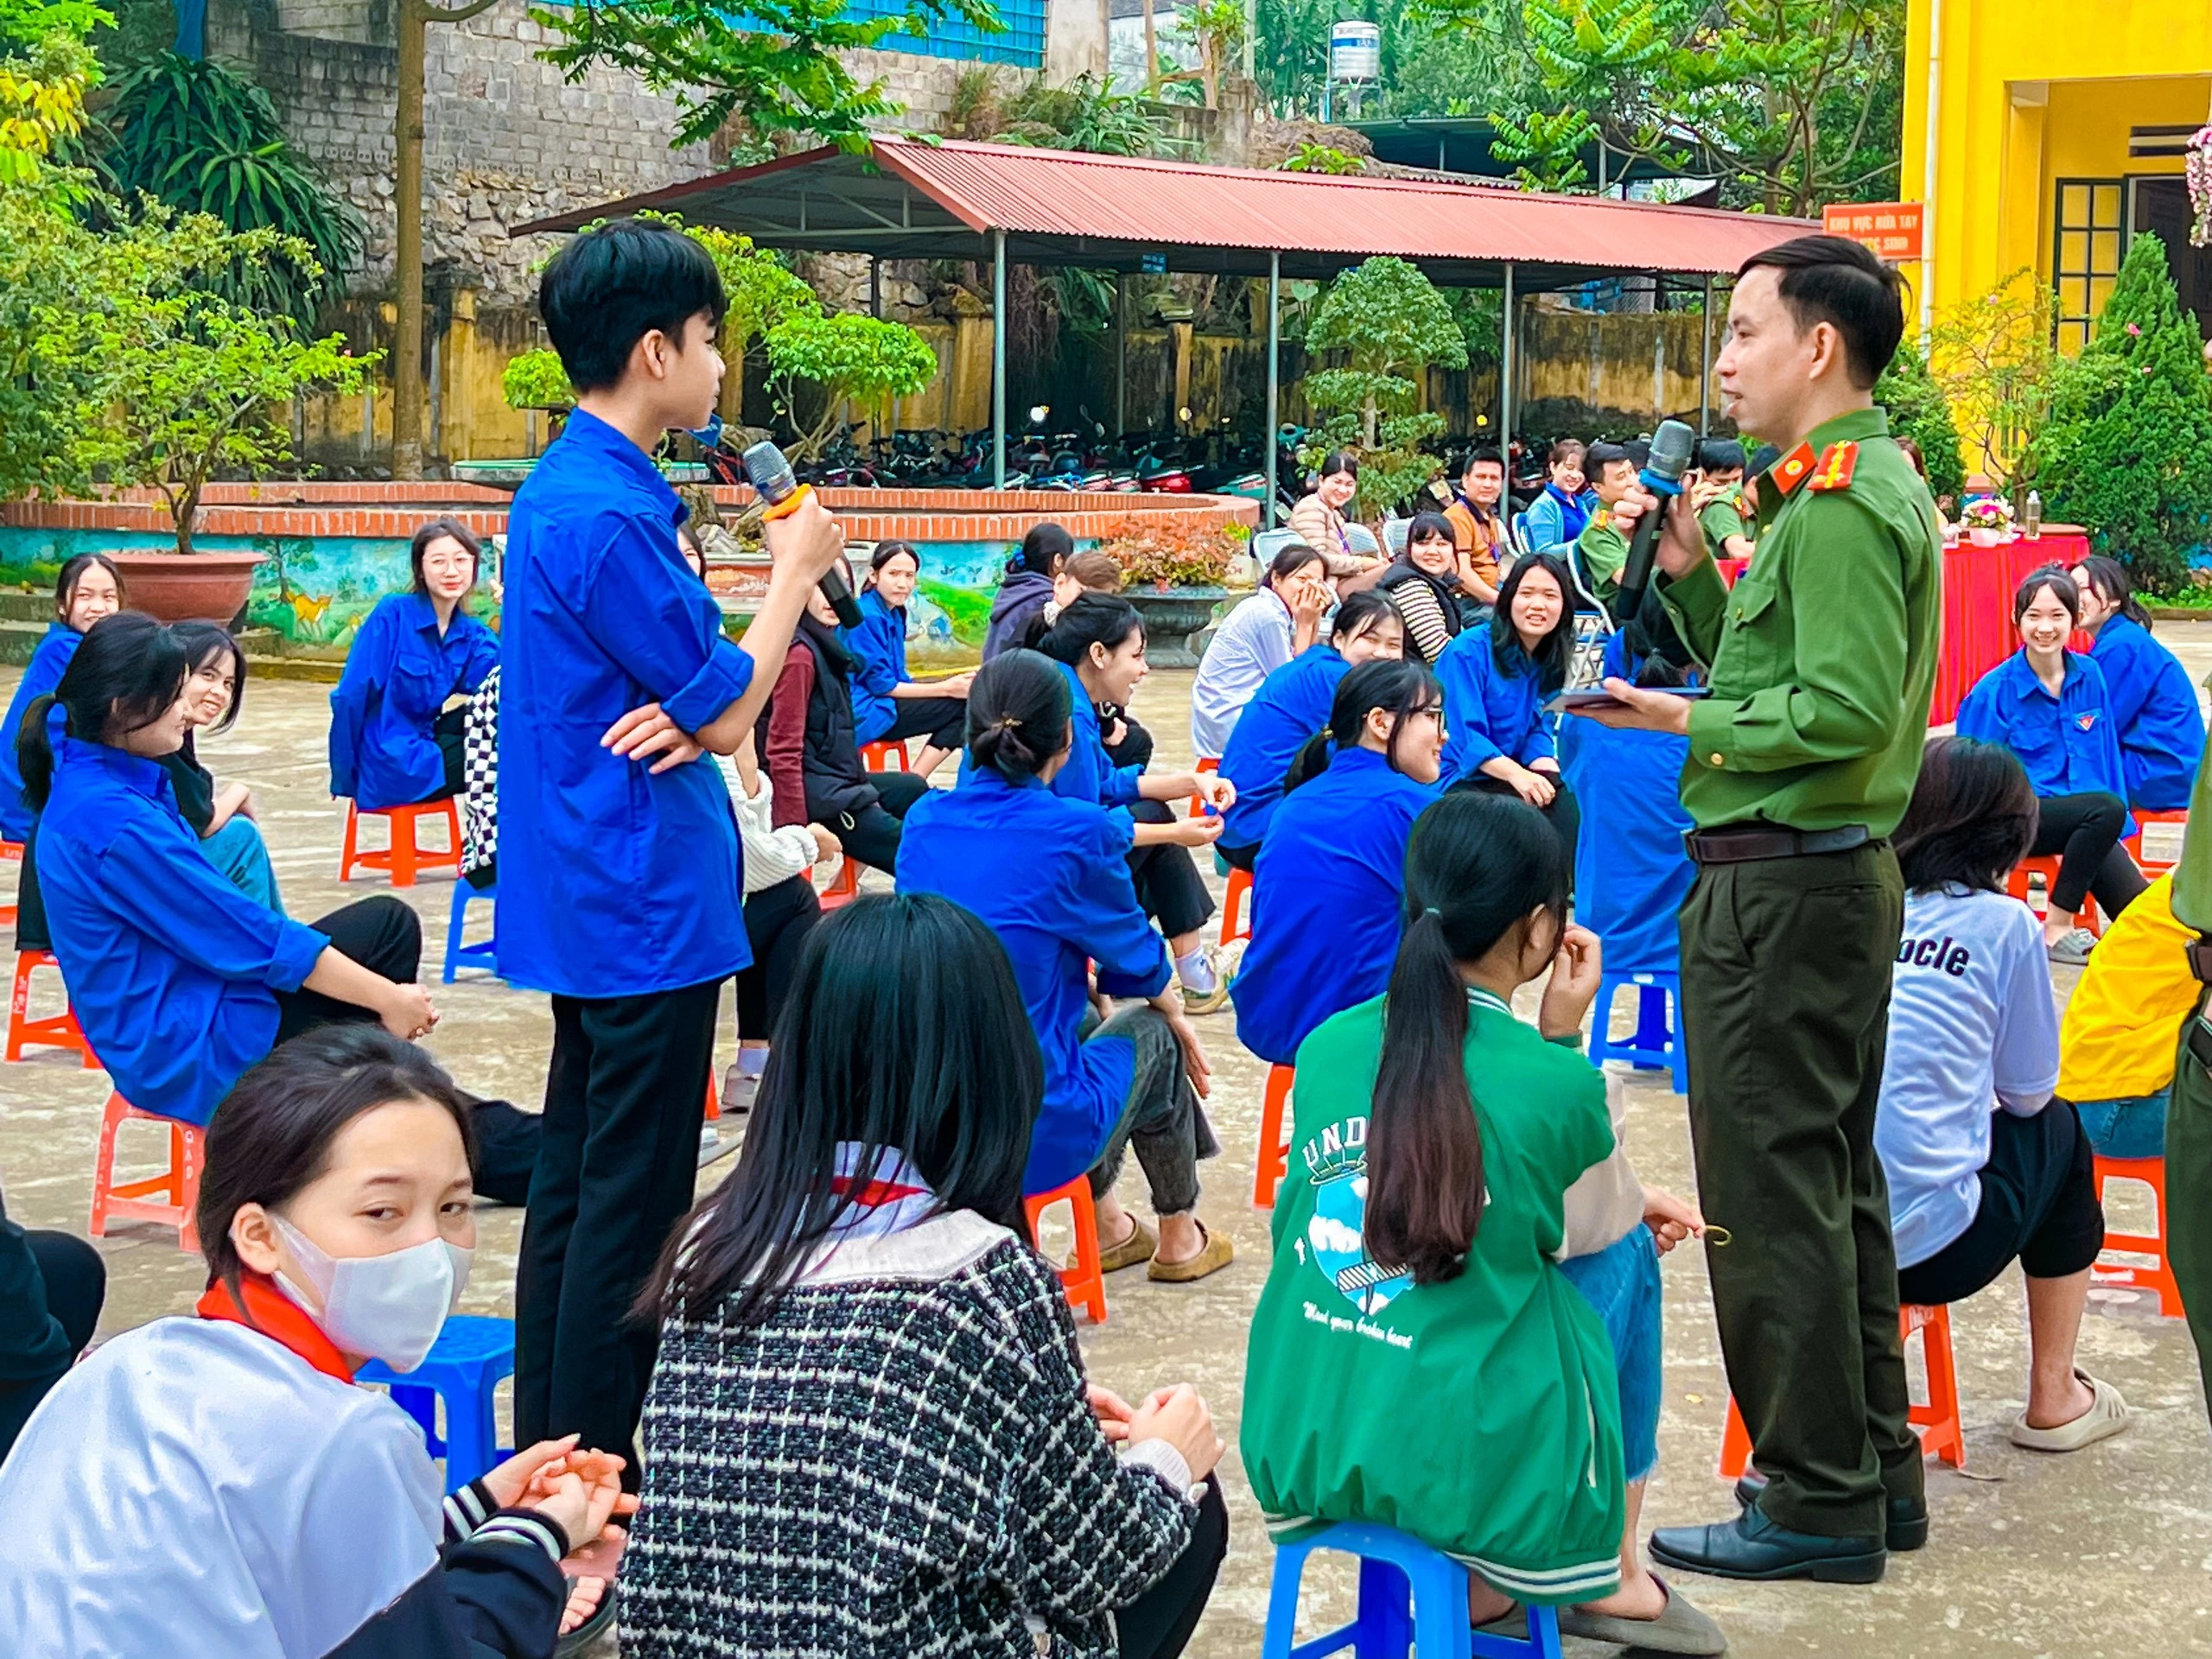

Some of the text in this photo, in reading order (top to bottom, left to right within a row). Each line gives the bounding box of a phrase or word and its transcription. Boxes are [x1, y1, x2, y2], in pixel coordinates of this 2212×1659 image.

[1899, 214, 1918, 229] TAY
[1895, 936, 1969, 976] ocle
[1301, 1116, 1369, 1167] UND
